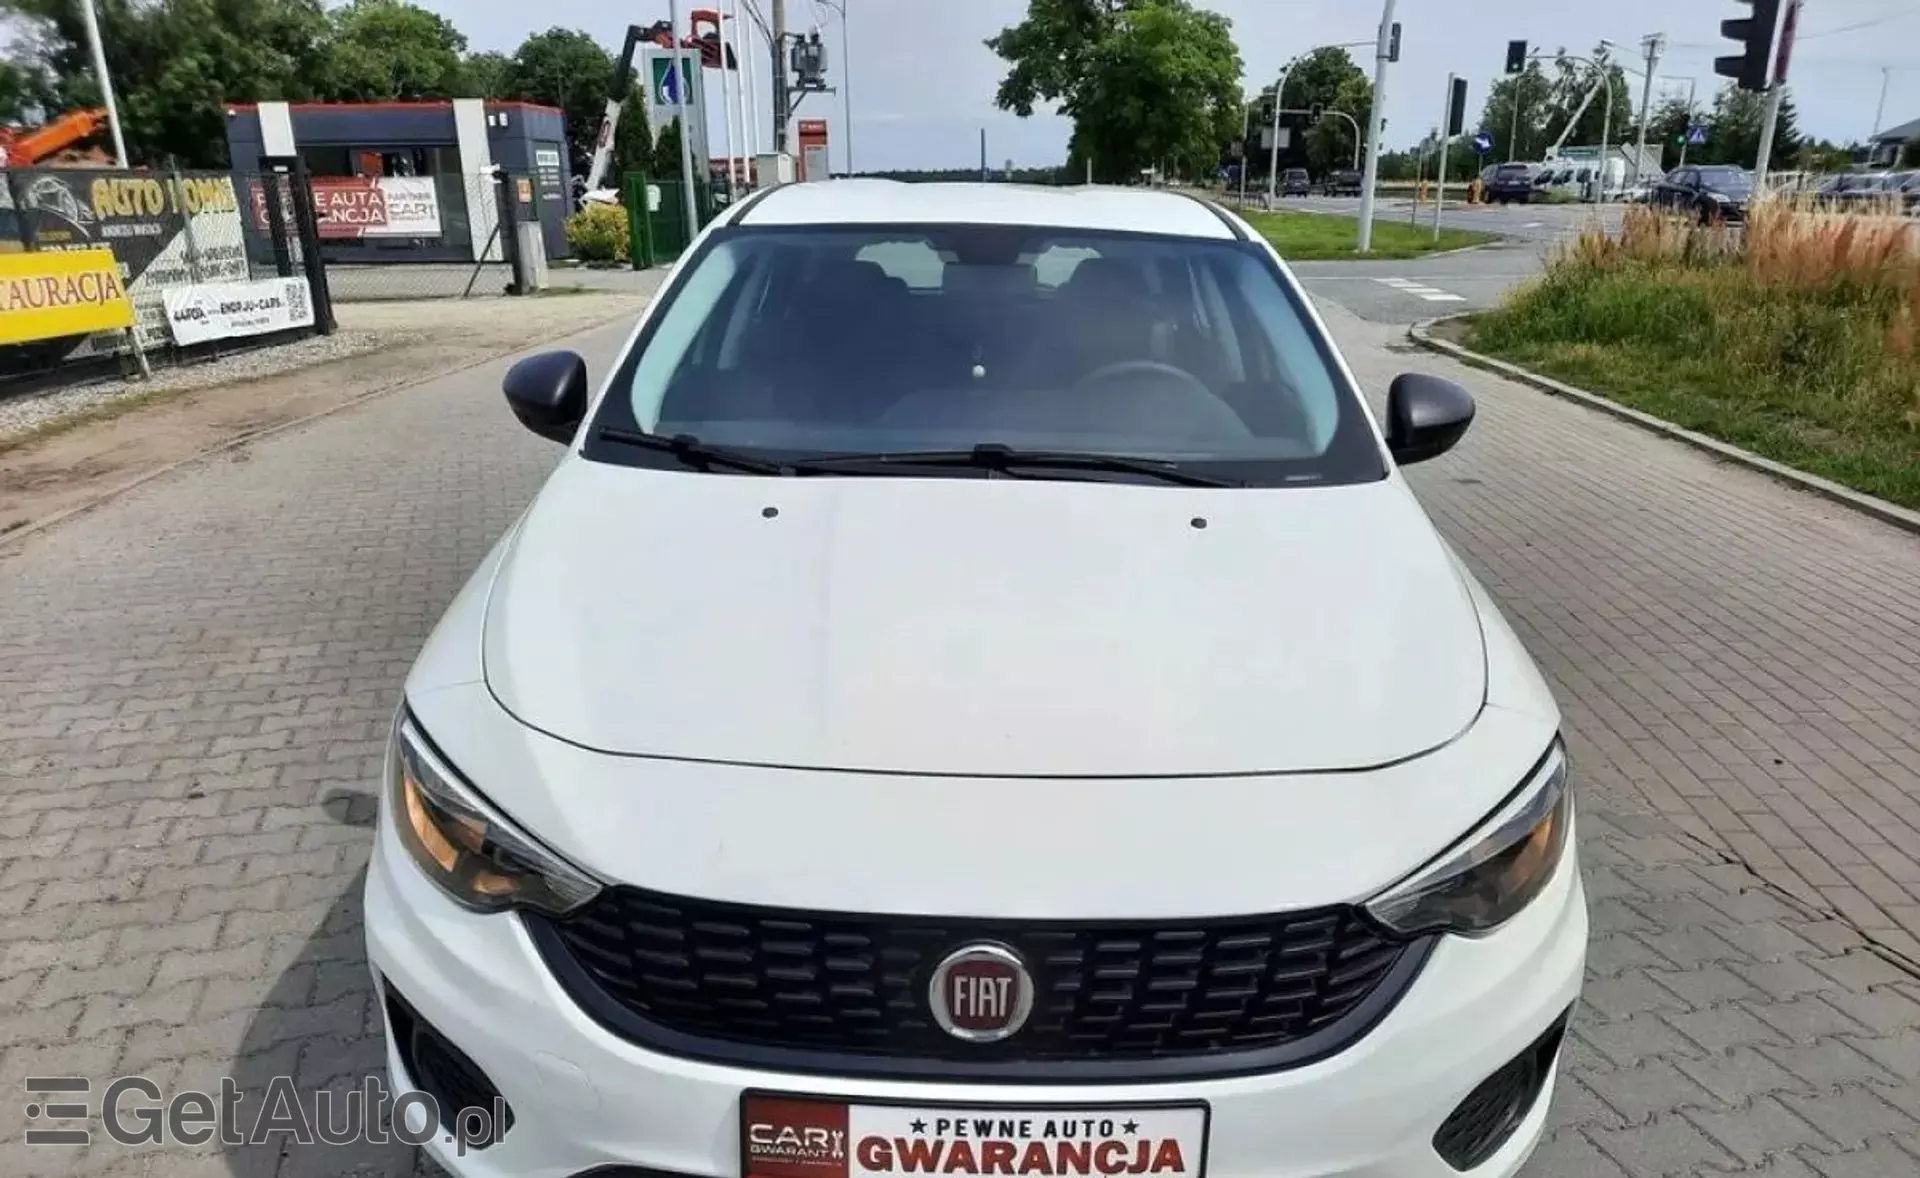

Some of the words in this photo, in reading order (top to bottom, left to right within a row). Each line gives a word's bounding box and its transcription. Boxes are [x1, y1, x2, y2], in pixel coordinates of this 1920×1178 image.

[92, 177, 164, 221] AUTO
[330, 191, 384, 207] AUTA
[953, 975, 1012, 1017] FIAT
[750, 1124, 829, 1147] CAR
[935, 1118, 1040, 1138] PEWNE
[1043, 1119, 1114, 1138] AUTO
[750, 1144, 829, 1158] GWARANT
[857, 1136, 1186, 1176] GWARANCJA
